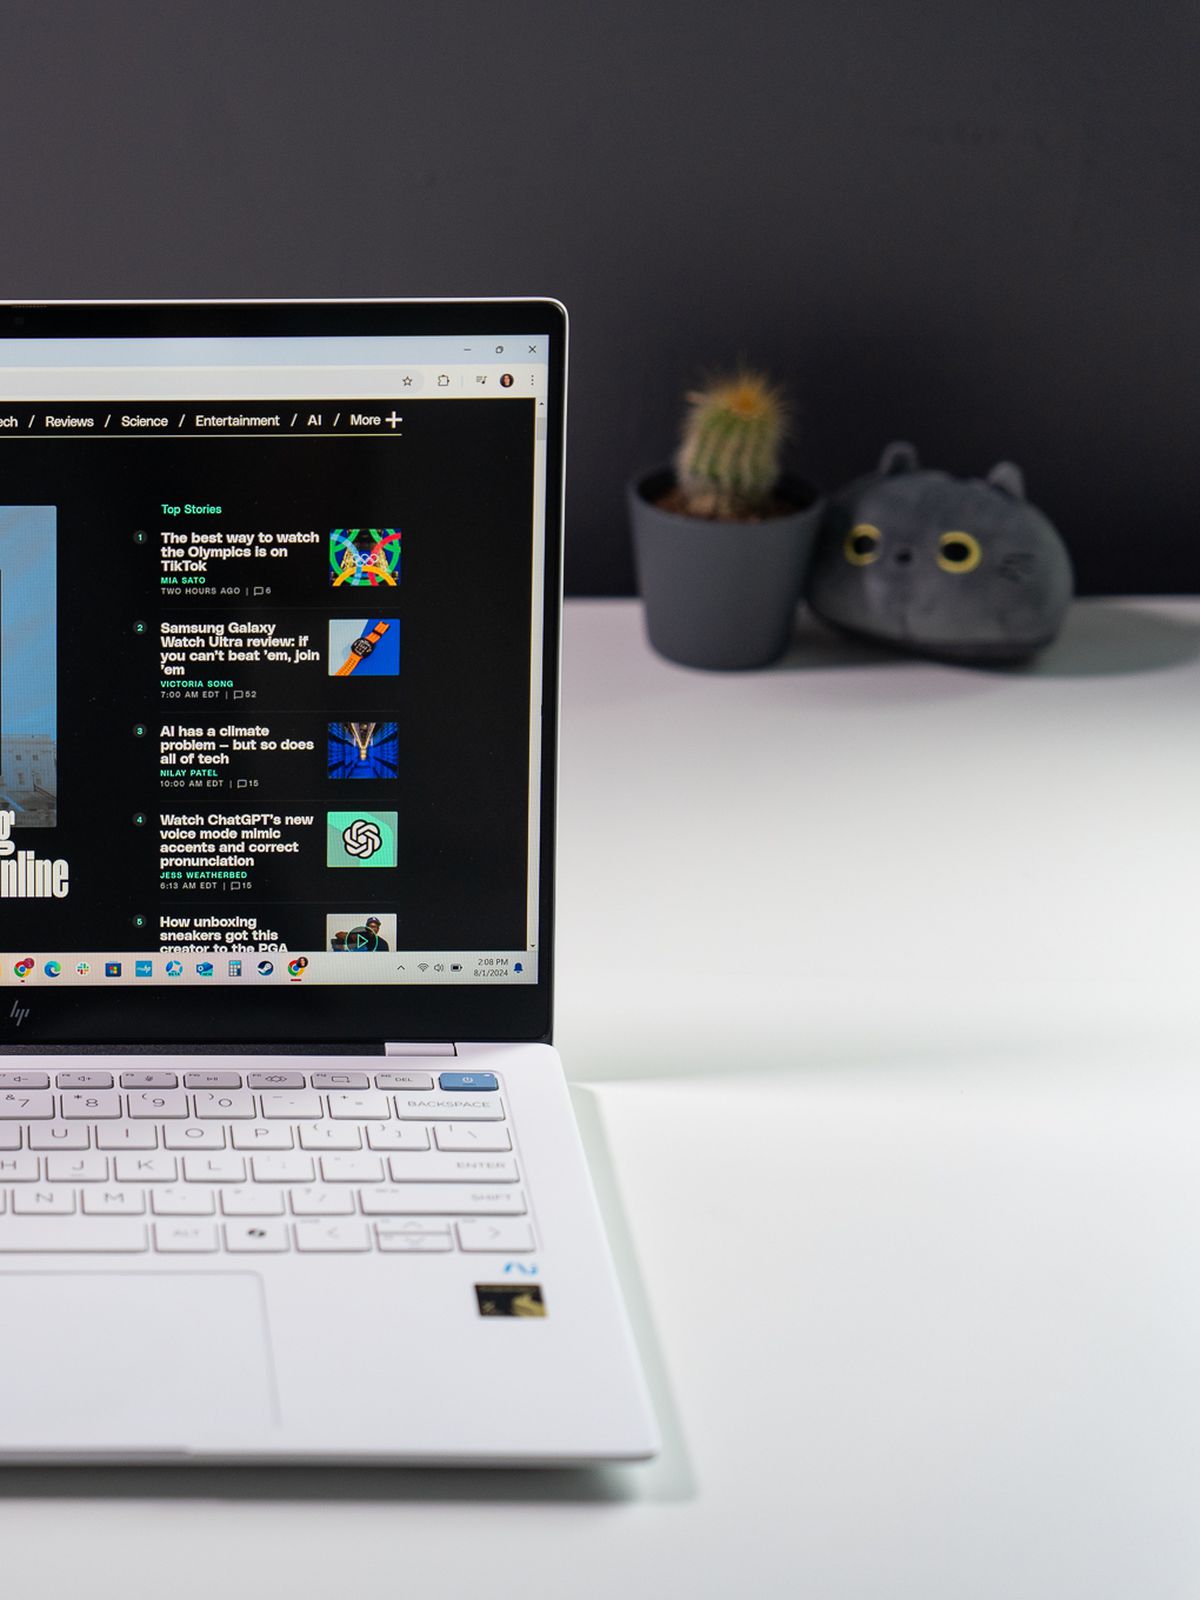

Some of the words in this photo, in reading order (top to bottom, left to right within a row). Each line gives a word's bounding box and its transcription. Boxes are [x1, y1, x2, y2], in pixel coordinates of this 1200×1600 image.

[45, 415, 94, 428] Reviews
[121, 414, 169, 427] Science
[195, 414, 280, 427] Entertainment
[307, 414, 322, 426] AI
[350, 414, 382, 426] More
[160, 504, 181, 517] Top
[184, 504, 222, 514] Stories
[160, 532, 188, 544] The
[191, 532, 223, 544] best
[226, 534, 255, 547] way
[257, 532, 274, 544] to
[276, 531, 320, 544] watch
[160, 546, 185, 558] the
[187, 546, 252, 560] Olympics
[254, 545, 268, 558] is
[270, 547, 288, 558] on
[160, 560, 207, 572] TikTok
[160, 576, 178, 584] MIA
[181, 576, 206, 585] SATO
[160, 587, 182, 595] TWO
[185, 587, 217, 595] HOURS
[220, 586, 241, 595] AGO
[160, 622, 225, 636] Samsung
[227, 622, 277, 636] Galaxy
[160, 636, 206, 648] Watch
[208, 636, 243, 648] Ultra
[246, 636, 295, 648] review:
[298, 635, 309, 647] if
[160, 652, 186, 665] you
[228, 649, 261, 661] beat
[293, 649, 320, 664] join
[160, 680, 204, 688] VICTORIA
[207, 680, 234, 688] SONG
[160, 690, 181, 699] 7:00
[184, 690, 199, 698] AM
[202, 690, 220, 698] EDT
[160, 725, 175, 737] AI
[178, 725, 204, 737] has
[206, 727, 216, 737] a
[219, 725, 270, 737] climate
[160, 739, 216, 754] problem
[232, 739, 257, 750] but
[260, 740, 278, 750] so
[280, 738, 315, 750] does
[160, 751, 176, 765] all
[179, 752, 195, 764] of
[197, 752, 230, 764] tech
[160, 769, 187, 777] NILAY
[190, 768, 218, 777] PATEL
[160, 780, 186, 788] 10:00
[206, 779, 224, 788] EDT
[160, 814, 204, 826] Watch
[285, 816, 314, 826] new
[159, 828, 196, 840] voice
[199, 827, 238, 840] mode
[241, 827, 281, 839] mimic
[159, 842, 216, 853] accents
[218, 841, 245, 853] and
[248, 841, 299, 853] correct
[160, 854, 255, 870] pronunciation
[160, 871, 183, 879] JESS
[186, 871, 248, 879] WEATHERBED
[160, 882, 179, 890] 6:13
[200, 881, 217, 890] EDT
[160, 916, 191, 928] How
[193, 916, 257, 930] unboxing
[159, 929, 222, 941] sneakers
[225, 930, 249, 944] got
[250, 928, 279, 941] this
[159, 944, 210, 952] creator
[212, 943, 228, 952] to
[231, 943, 255, 952] the
[258, 942, 289, 952] PGA
[19, 1098, 30, 1108] 7
[85, 1098, 99, 1108] 8
[152, 1098, 166, 1107] 9
[218, 1098, 233, 1108] 0
[407, 1100, 490, 1108] BACKSPACE
[51, 1128, 68, 1138] U
[125, 1128, 129, 1138] I
[184, 1127, 205, 1138] O
[254, 1128, 270, 1138] P
